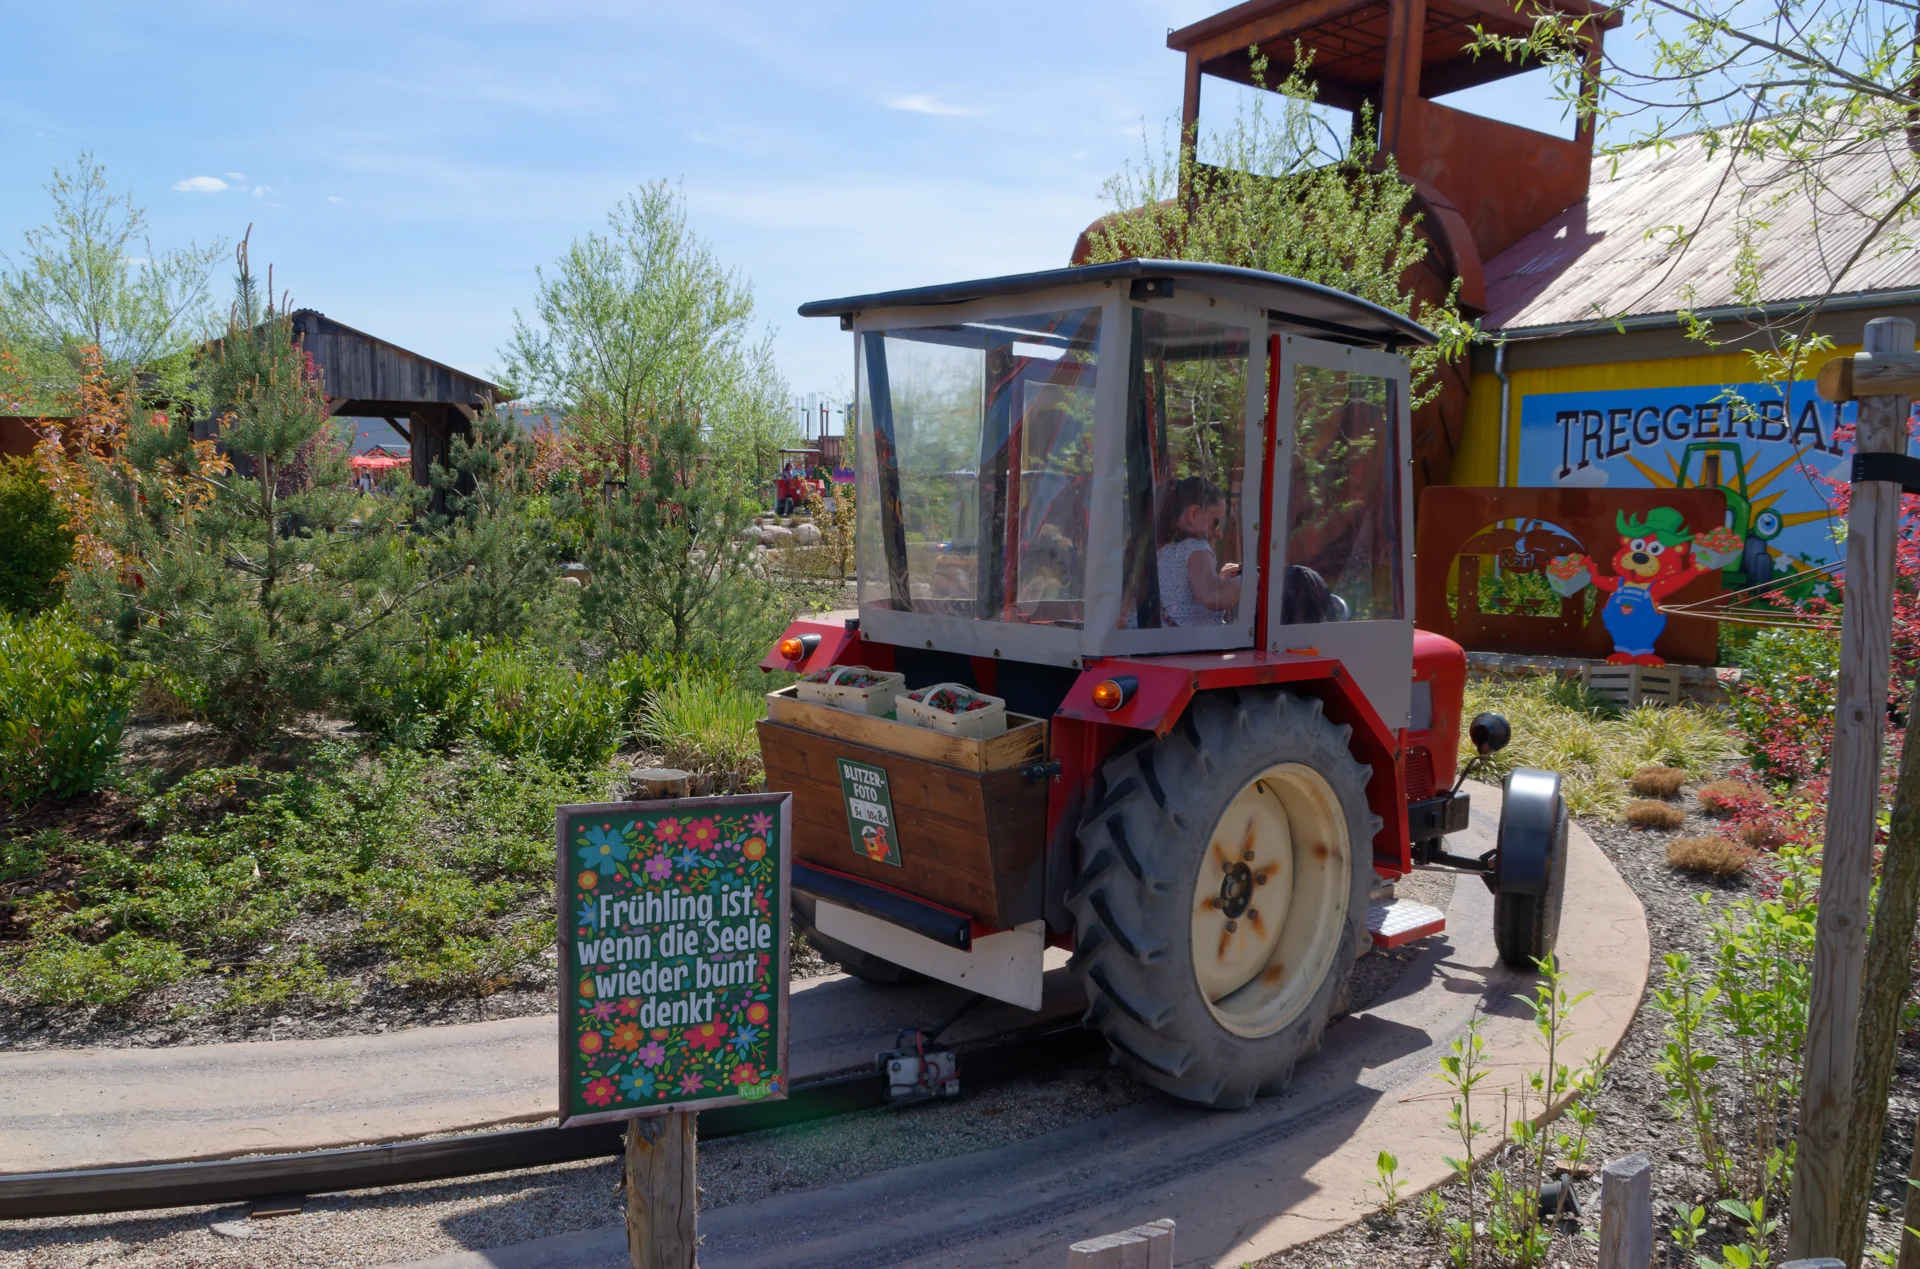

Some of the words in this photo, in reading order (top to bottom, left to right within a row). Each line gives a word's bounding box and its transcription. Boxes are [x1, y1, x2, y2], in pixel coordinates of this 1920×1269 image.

[1556, 399, 1911, 480] TREGGERBA
[843, 764, 885, 788] BLITZER-
[853, 782, 878, 802] FOTO
[600, 888, 712, 928] Frühling
[577, 934, 651, 965] wenn
[659, 923, 698, 958] die
[706, 918, 771, 953] Seele
[595, 962, 689, 999] wieder
[696, 953, 757, 989] bunt
[640, 991, 715, 1029] denkt
[740, 1083, 771, 1097] Karls
